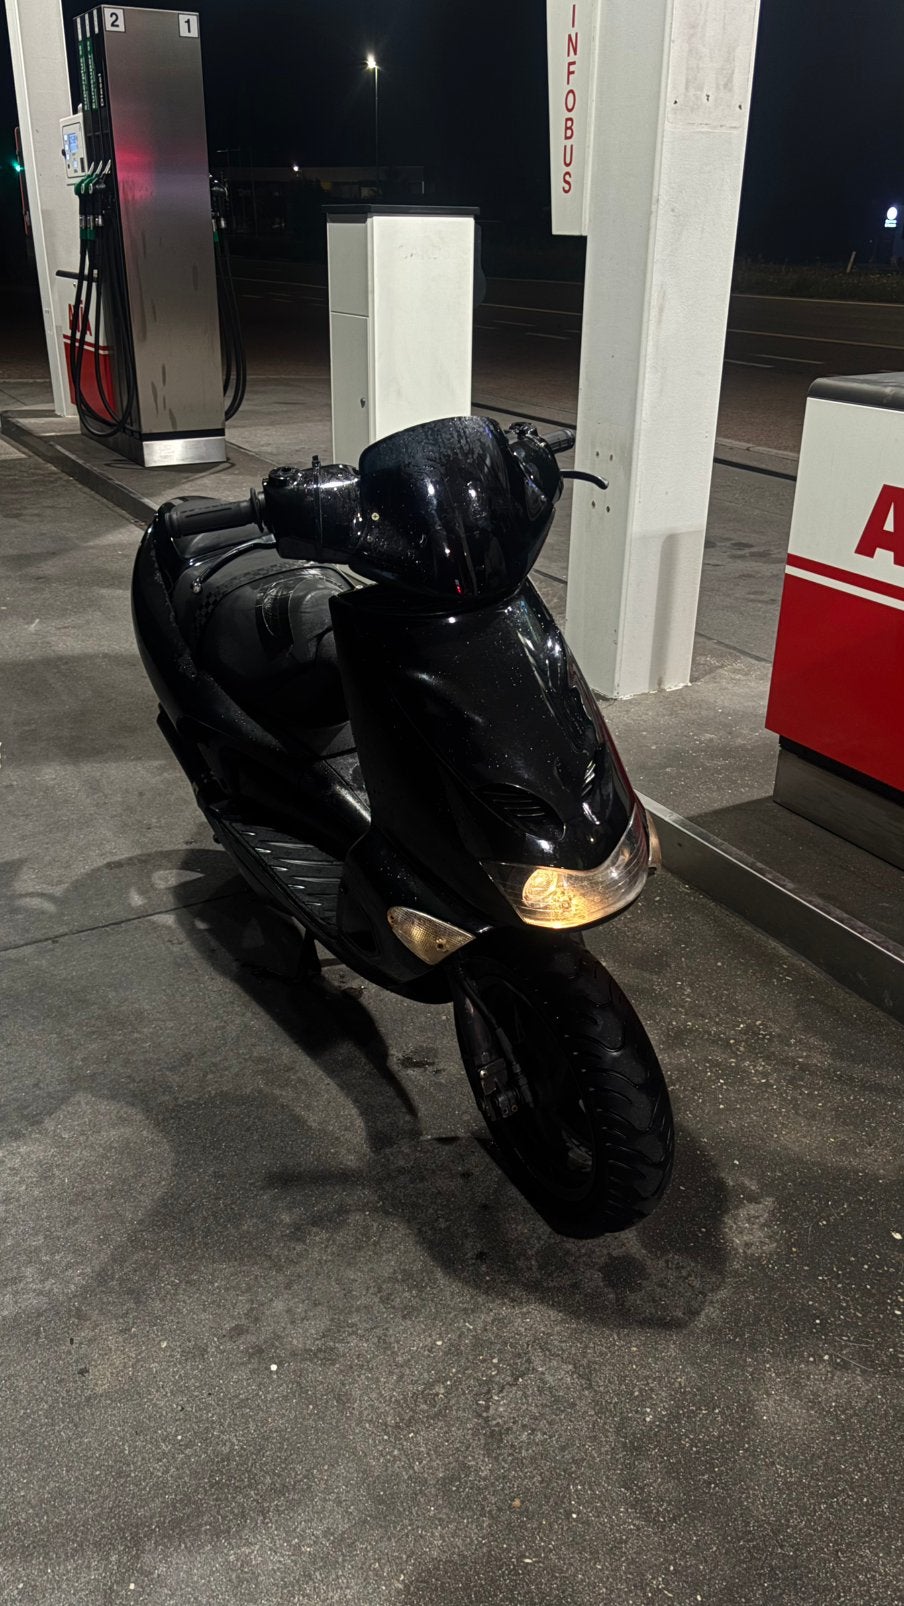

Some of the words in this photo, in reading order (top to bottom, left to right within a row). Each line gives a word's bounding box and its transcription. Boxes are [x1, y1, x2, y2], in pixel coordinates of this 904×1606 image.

[110, 12, 119, 28] 2
[184, 18, 191, 33] 1
[562, 4, 578, 194] INFOBUS
